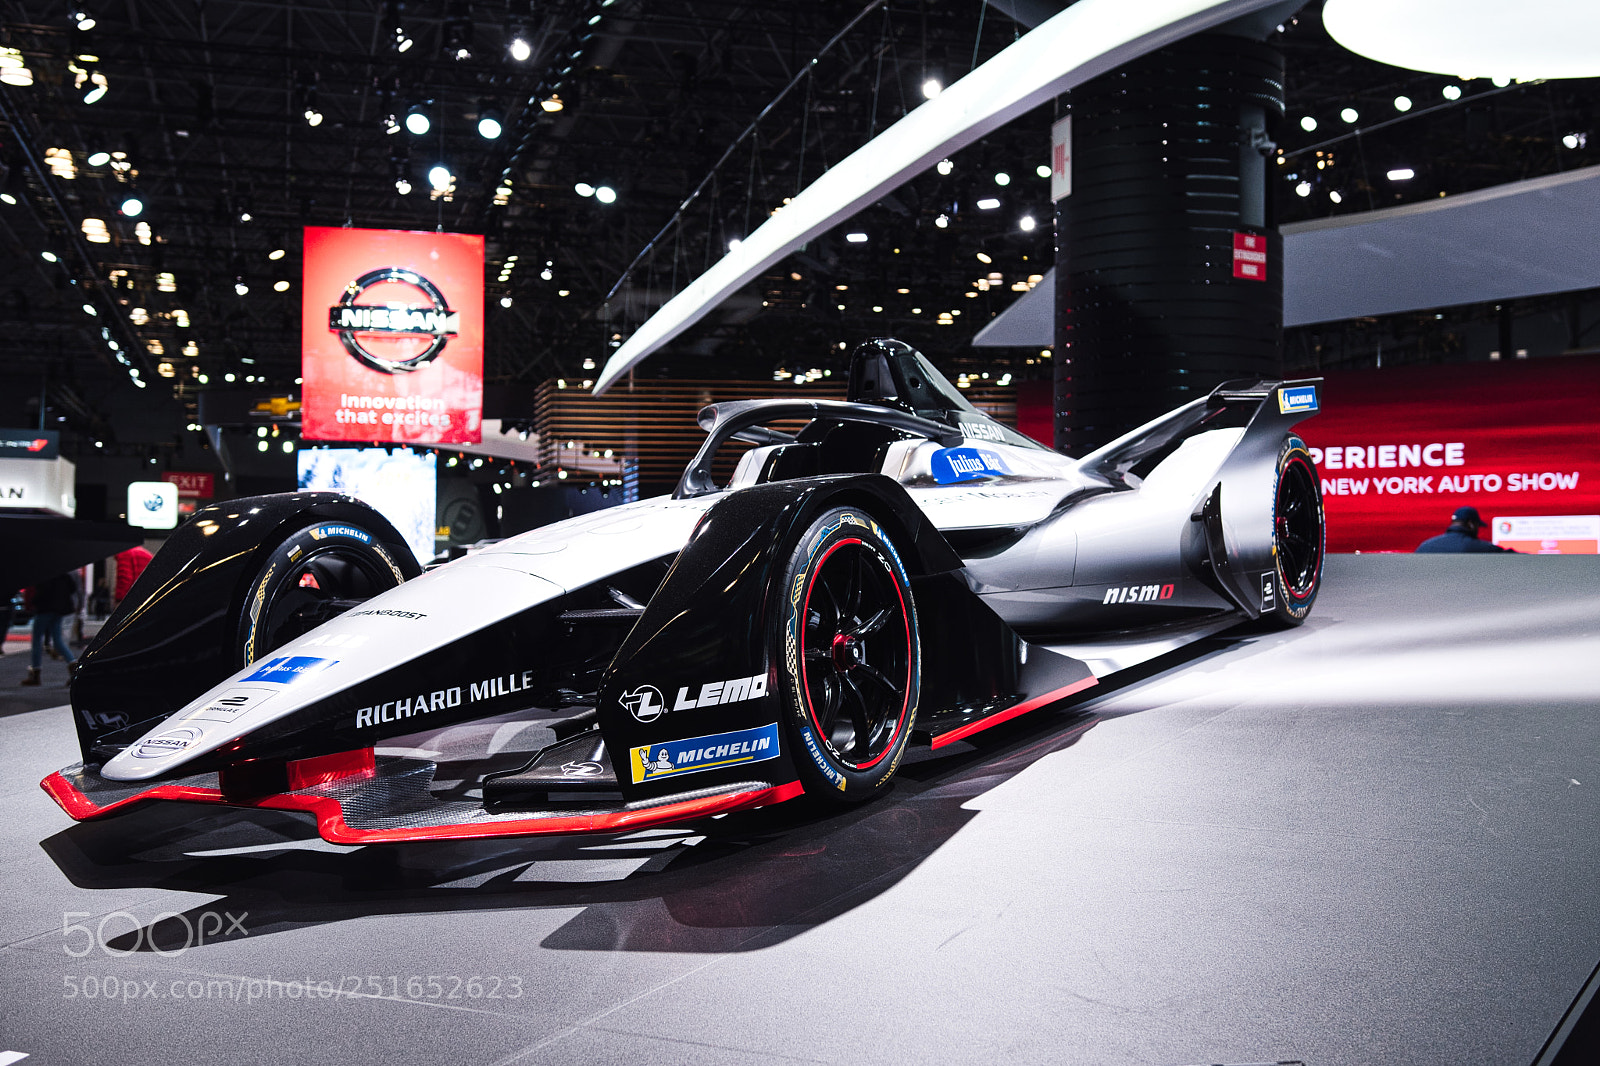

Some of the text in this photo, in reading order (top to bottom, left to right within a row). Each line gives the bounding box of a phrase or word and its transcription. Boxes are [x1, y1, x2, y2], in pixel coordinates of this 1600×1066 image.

[341, 308, 447, 331] NISSAN
[341, 394, 445, 411] Innovation
[335, 409, 451, 427] that excites
[957, 422, 1006, 442] NISSAN
[946, 453, 985, 478] Julius
[168, 475, 208, 489] EXIT
[1321, 471, 1580, 496] NEW YORK AUTO SHOW
[327, 526, 369, 542] MICHELIN
[356, 670, 534, 729] RICHARD MILLE
[672, 673, 769, 712] LEMO
[144, 739, 192, 748] NISSAN
[676, 736, 771, 764] MICHELIN
[803, 731, 836, 780] MICHELIN
